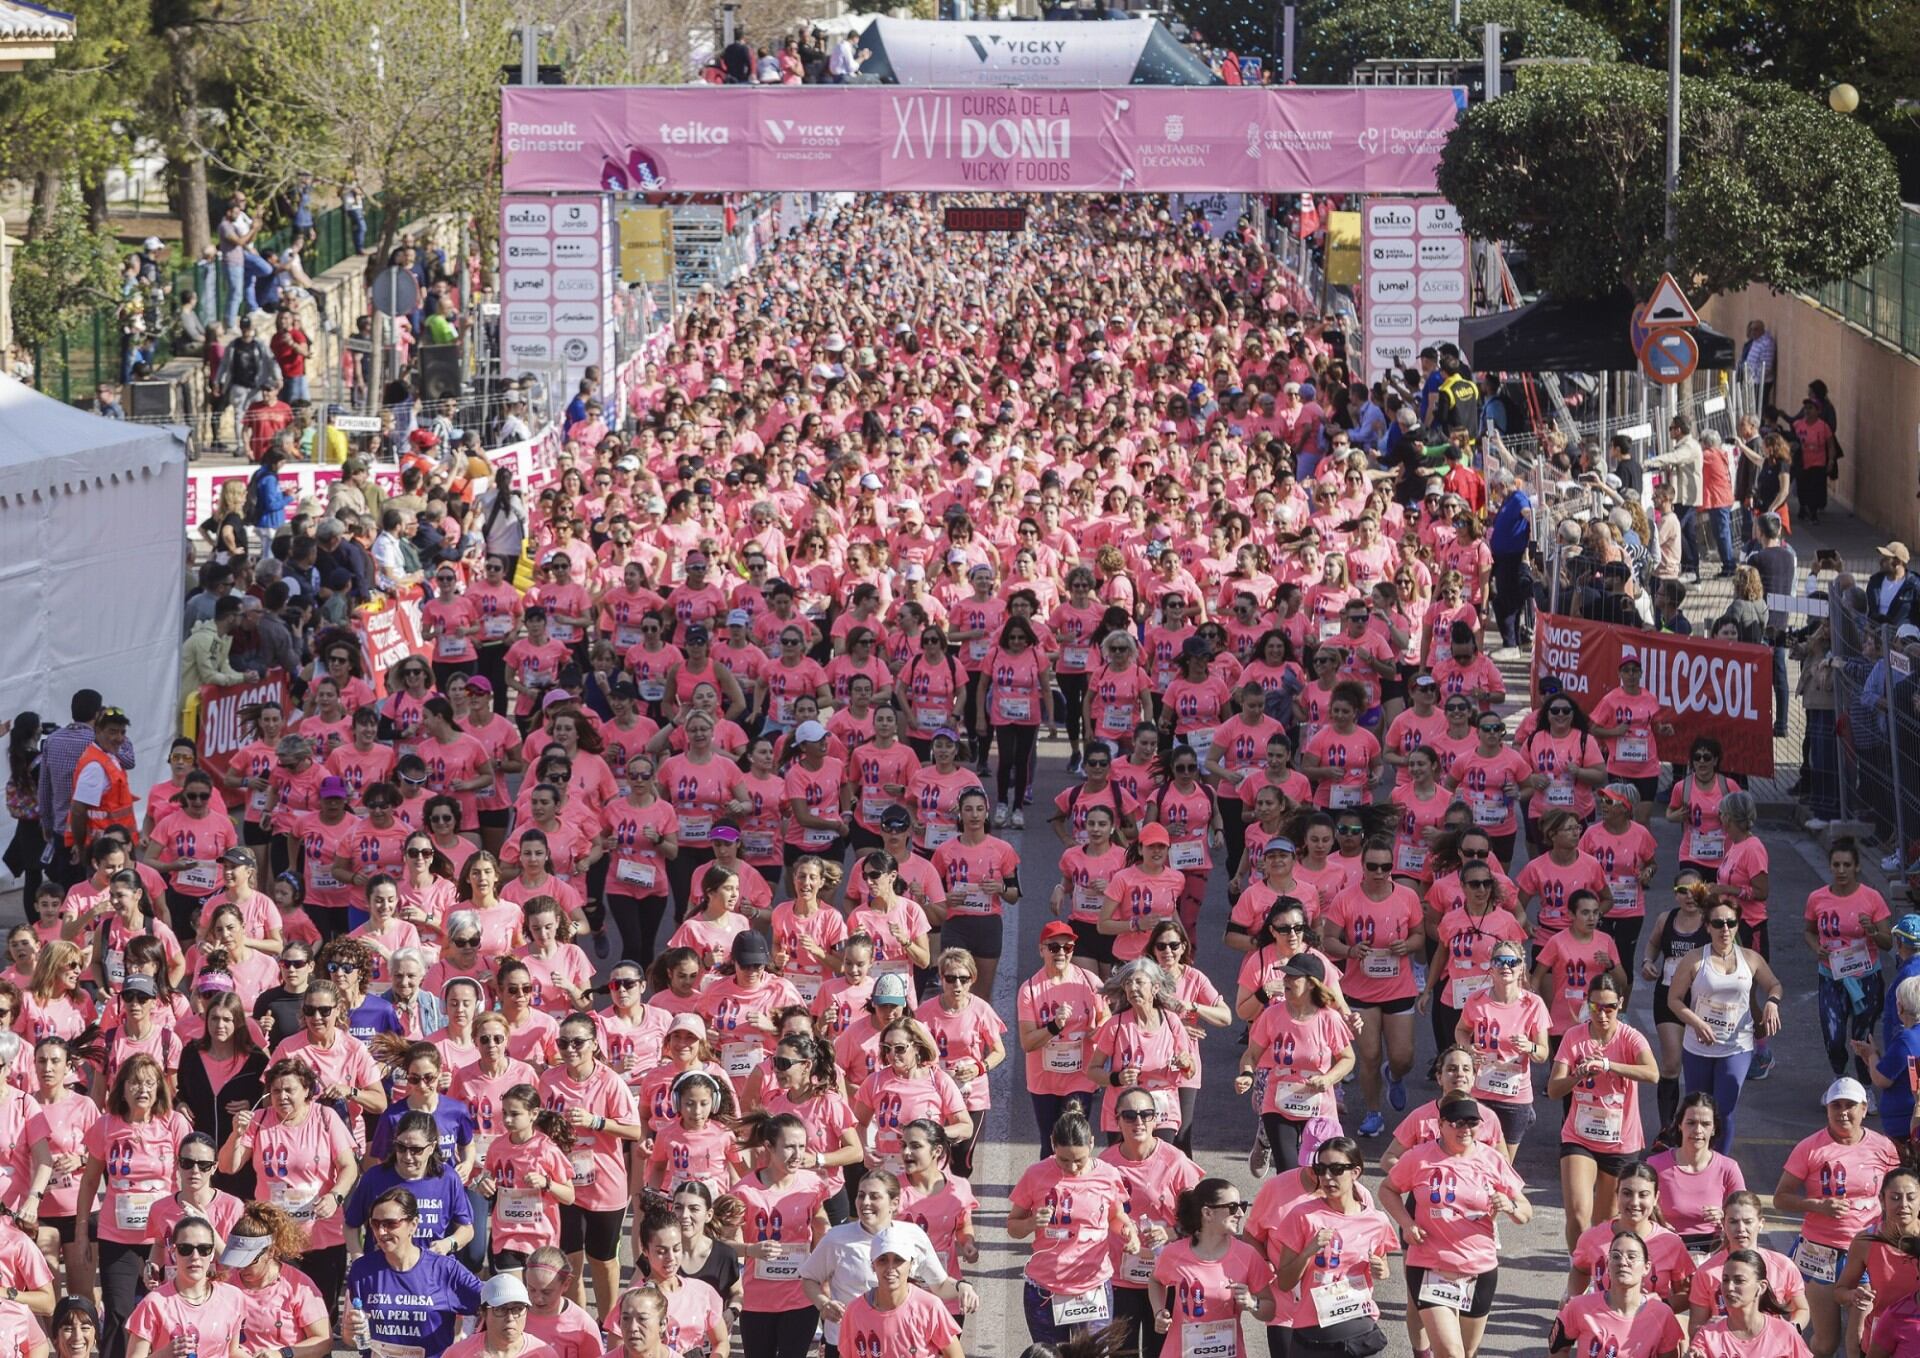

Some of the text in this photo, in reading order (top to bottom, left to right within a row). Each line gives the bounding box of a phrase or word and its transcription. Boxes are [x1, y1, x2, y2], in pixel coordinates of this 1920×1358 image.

[1008, 41, 1066, 53] VICKY
[1012, 55, 1060, 65] FOODS
[962, 96, 1070, 116] CURSA DE LA
[508, 122, 577, 136] Renault
[659, 121, 729, 145] teika
[798, 125, 845, 136] VICKY
[891, 96, 951, 159] XVI
[801, 137, 840, 146] FOODS
[961, 119, 1071, 159] DONA
[1264, 131, 1333, 141] GENERALITAT
[508, 138, 585, 153] Ginestar
[1137, 144, 1211, 155] AJUNTAMENT
[1264, 142, 1332, 151] VALENCIANA
[1391, 144, 1406, 154] de
[776, 150, 832, 160] FUNDACIÓN
[1143, 157, 1206, 168] DE GANDIA
[961, 162, 1071, 181] VICKY FOODS
[1379, 280, 1409, 293] jumel
[1549, 627, 1582, 649] MOS
[1548, 649, 1579, 670] QUE
[1703, 1016, 1727, 1027] 1502
[1051, 1060, 1076, 1068] 3564
[1489, 1080, 1509, 1089] 539
[1284, 1103, 1310, 1111] 1839
[1584, 1128, 1610, 1136] 1531
[416, 1198, 443, 1209] URSA
[426, 1213, 439, 1223] TU
[766, 1267, 797, 1275] 6557
[367, 1294, 434, 1306] ESTA CURSA
[1432, 1289, 1460, 1302] 3114
[371, 1309, 427, 1321] VA PER TU
[1064, 1306, 1097, 1317] 6502
[1329, 1303, 1360, 1318] 1857
[375, 1324, 421, 1337] NATALIA
[1193, 1345, 1226, 1355] 6333
